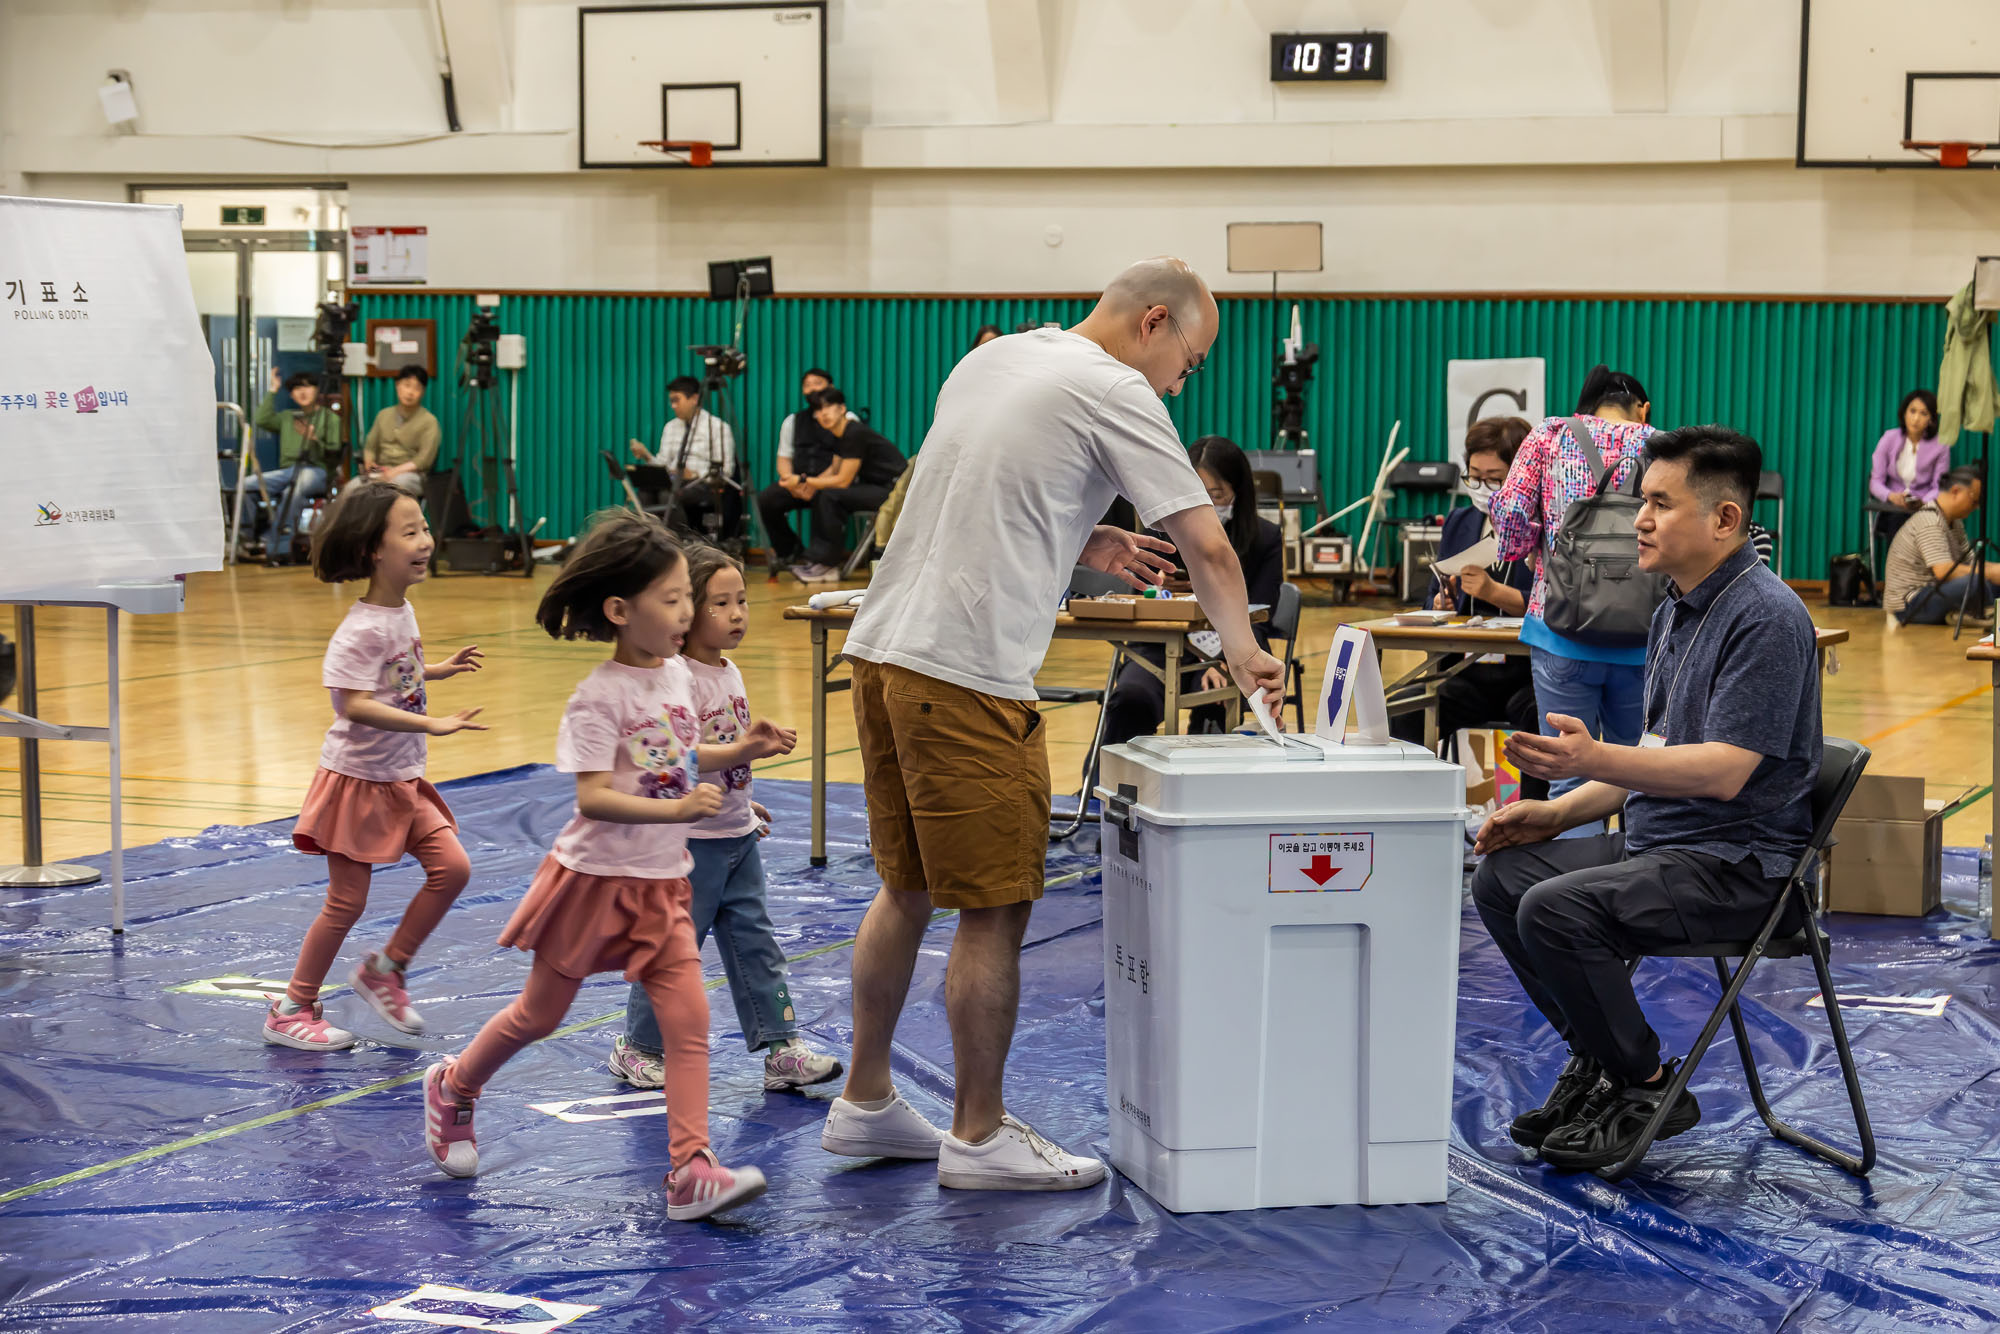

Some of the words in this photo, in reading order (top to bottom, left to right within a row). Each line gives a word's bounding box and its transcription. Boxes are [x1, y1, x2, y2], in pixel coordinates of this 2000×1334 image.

[1292, 42, 1322, 72] 10
[1333, 42, 1373, 72] 31
[14, 310, 55, 320] POLLING
[58, 310, 89, 320] BOOTH
[44, 390, 69, 409] 꽃은
[65, 509, 116, 522] 선거관리위원회
[1278, 843, 1300, 853] 이곳을
[1302, 842, 1317, 852] 잡고
[1319, 842, 1341, 852] 이동해
[1343, 841, 1365, 852] 주세요
[1115, 943, 1150, 994] 투표함
